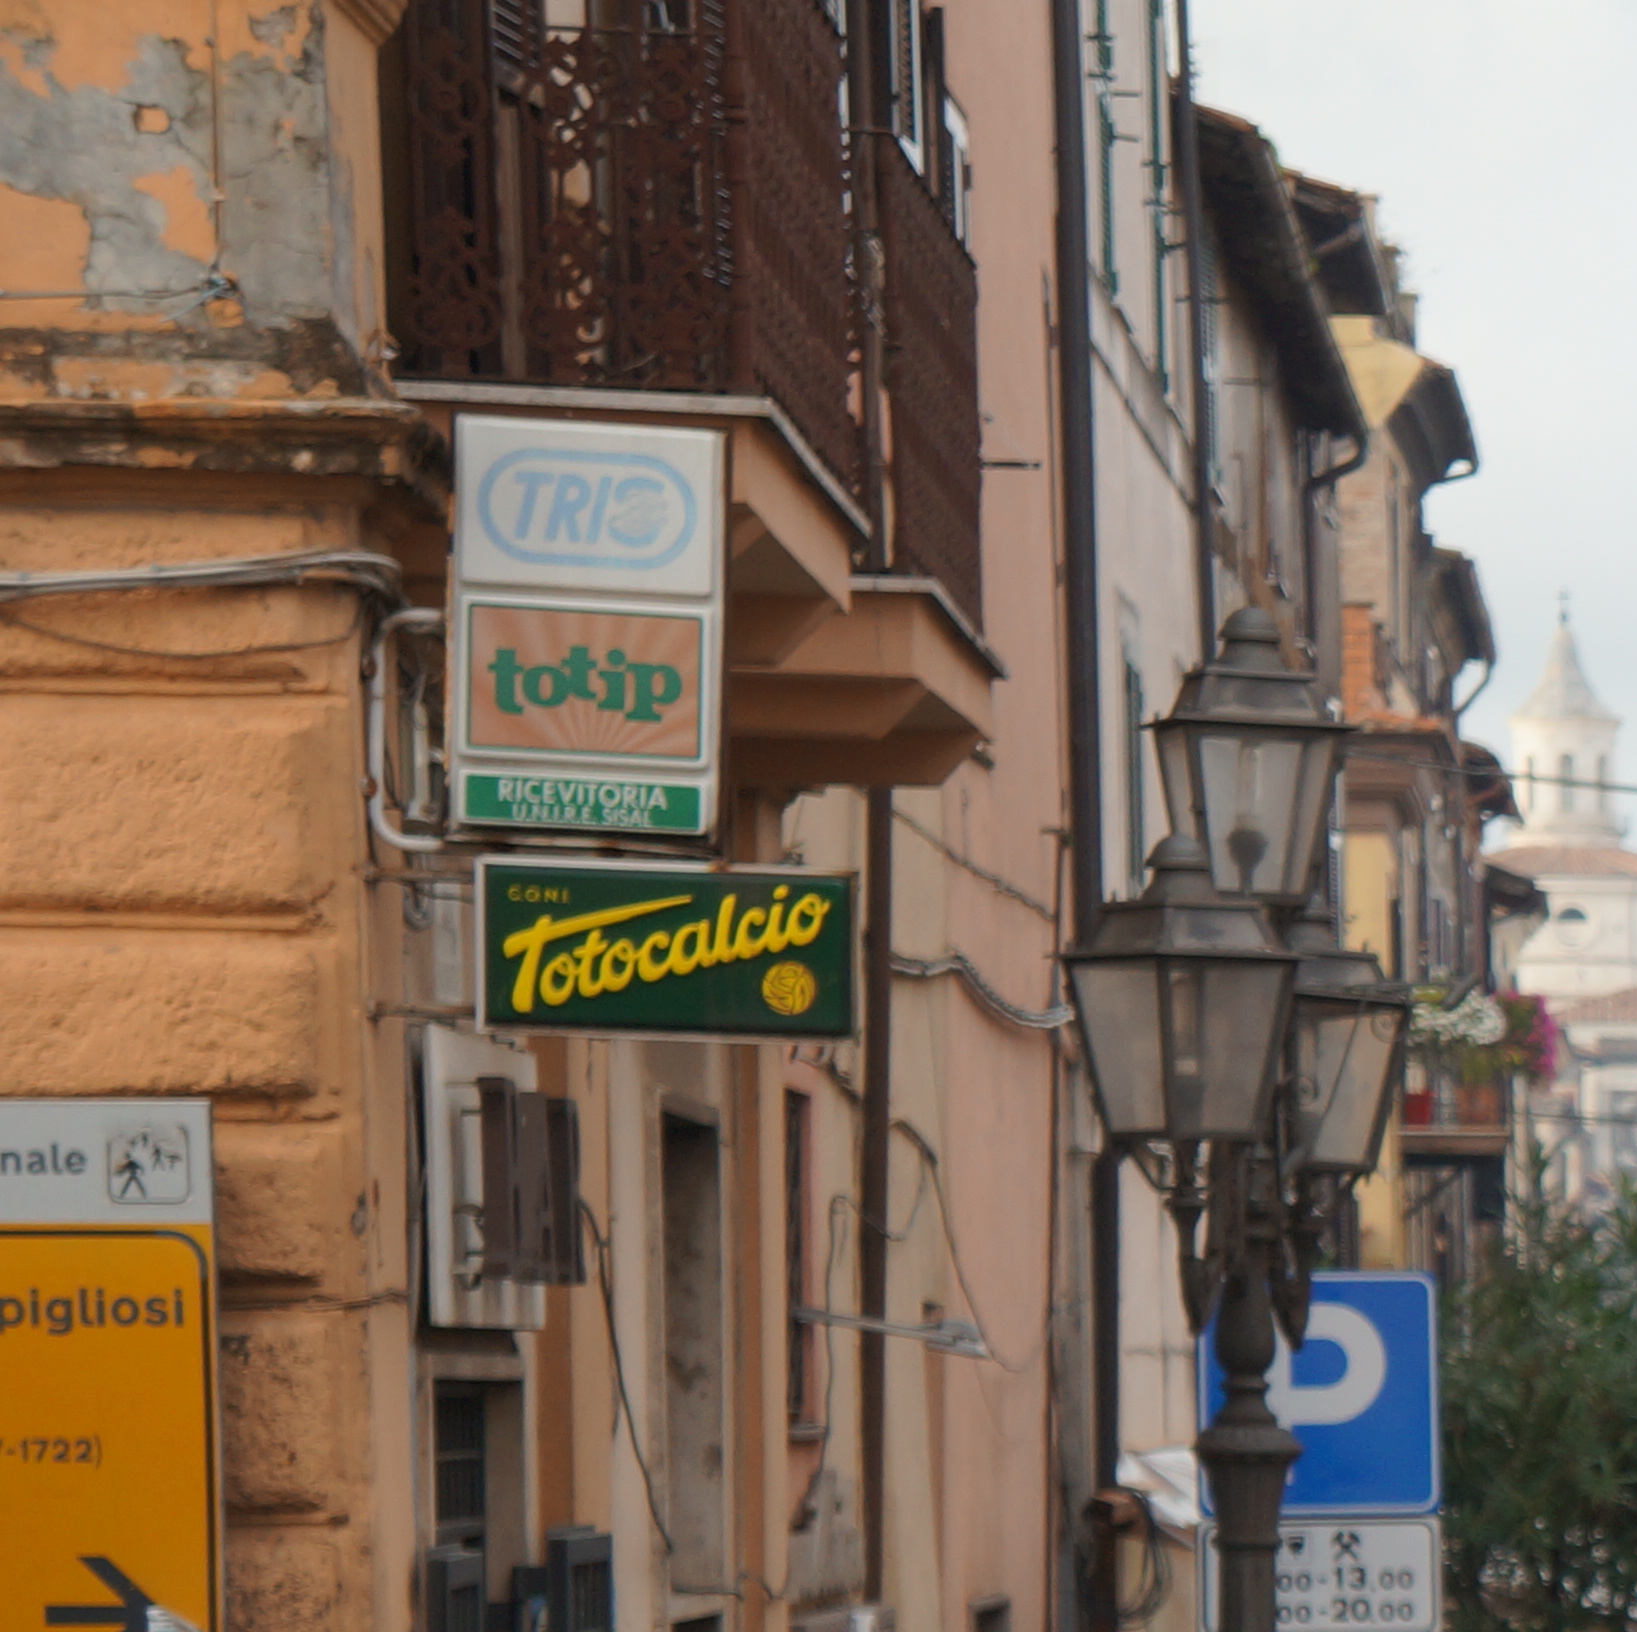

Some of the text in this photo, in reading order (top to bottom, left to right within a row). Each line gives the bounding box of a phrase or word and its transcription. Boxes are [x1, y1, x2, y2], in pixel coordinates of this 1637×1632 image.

[487, 645, 683, 723] totip
[497, 777, 669, 811] RICEVITORIA
[507, 884, 570, 904] CONI
[503, 885, 831, 1014] Totocalcio
[0, 1434, 102, 1469] -1722)
